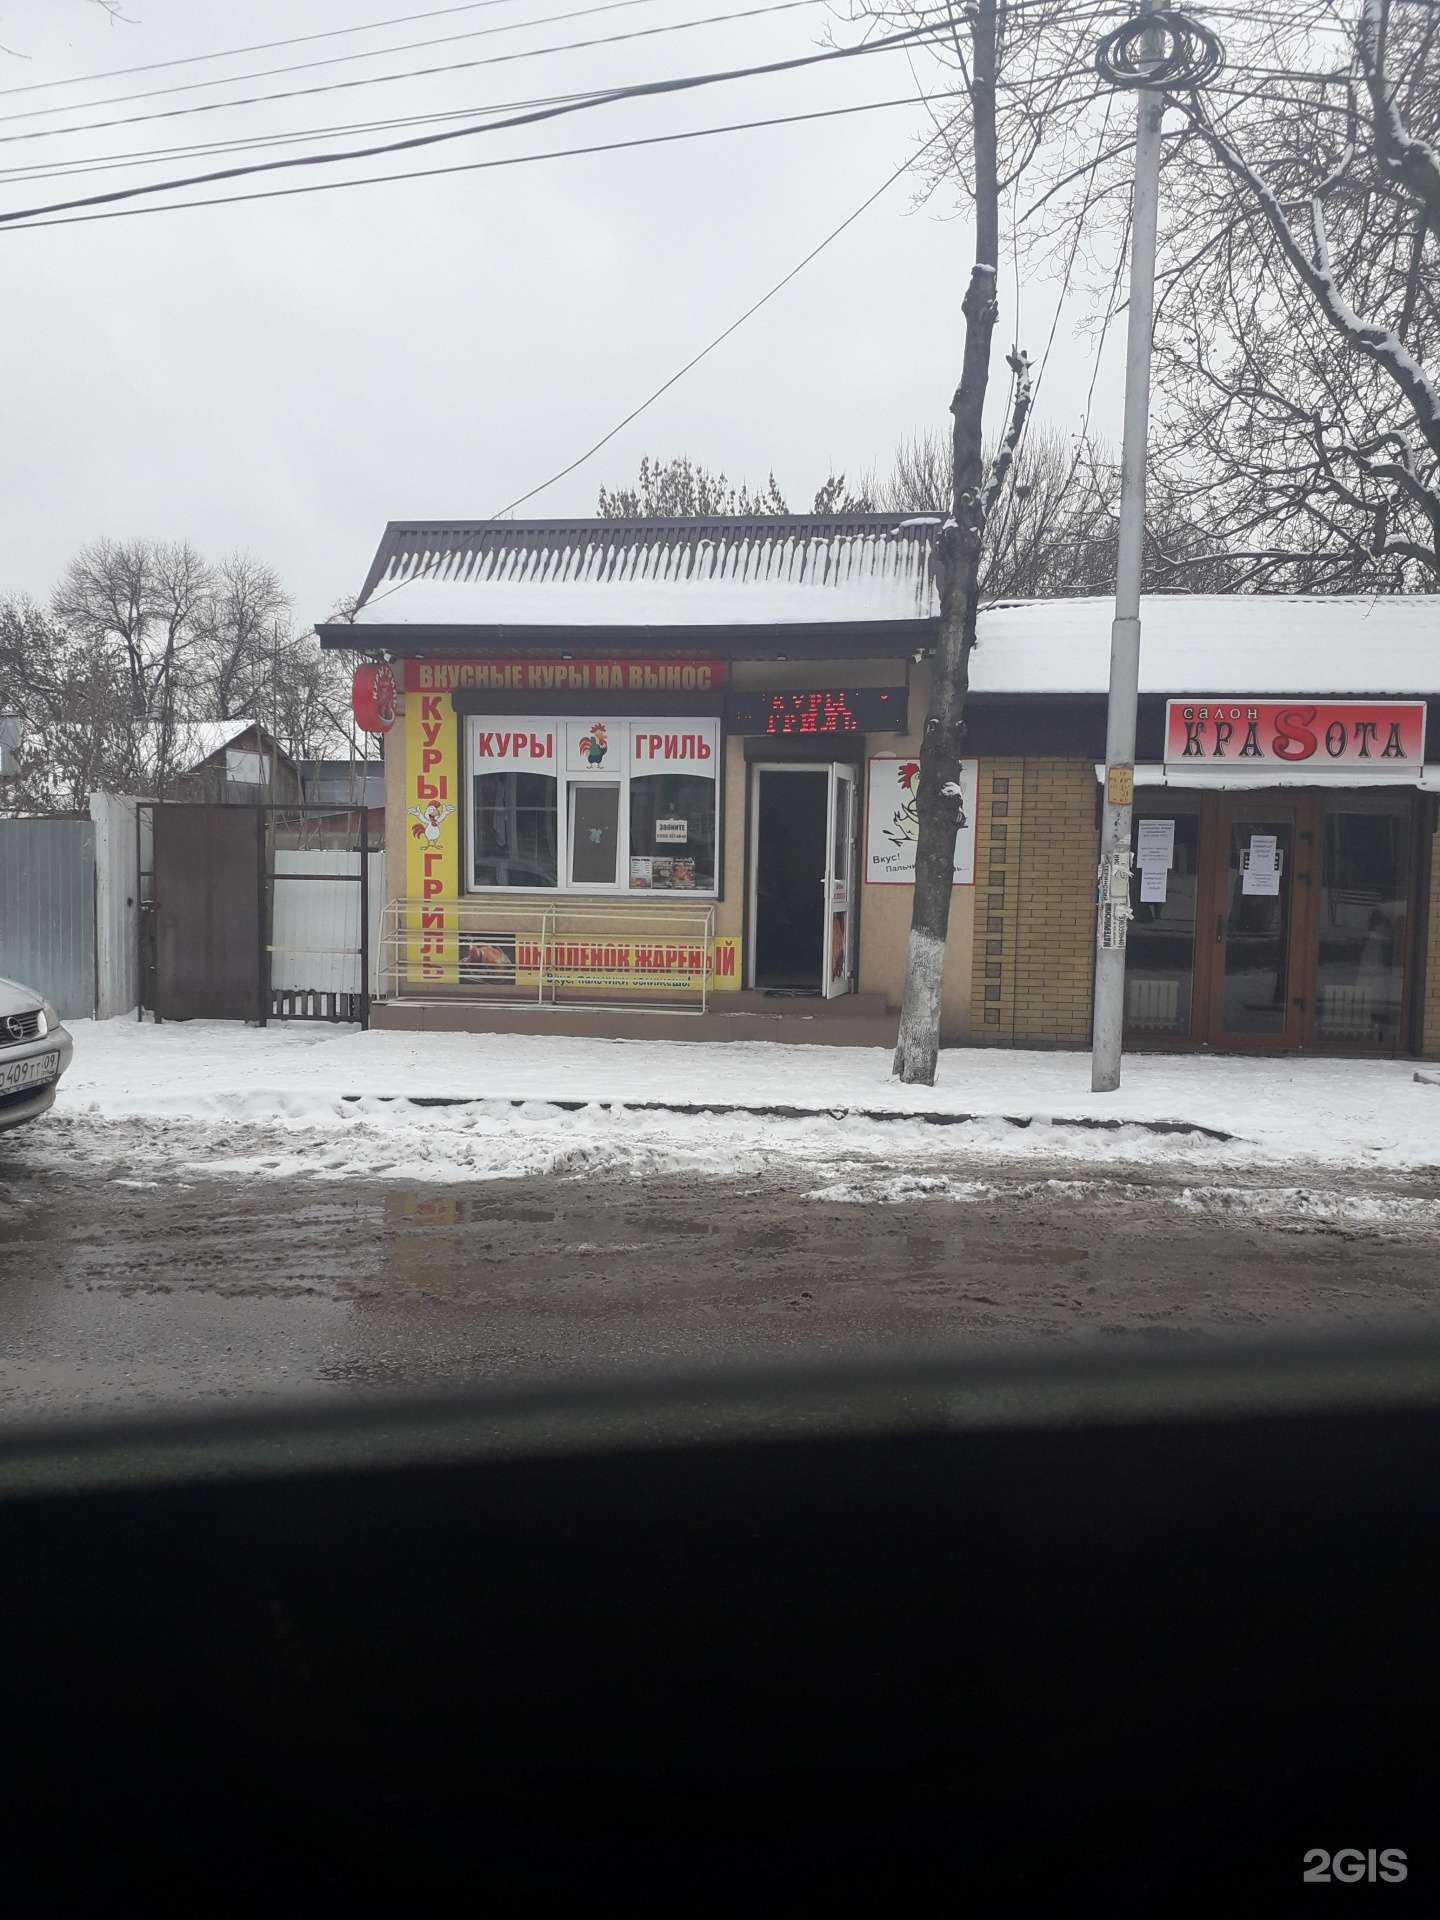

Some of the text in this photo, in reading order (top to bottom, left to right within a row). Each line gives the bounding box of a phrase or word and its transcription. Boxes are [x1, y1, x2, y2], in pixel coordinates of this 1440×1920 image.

[419, 665, 523, 689] ВКУСНЫЕ
[528, 665, 589, 689] КУРЫ
[595, 666, 622, 689] НА
[629, 666, 712, 690] ВЫНОС
[1183, 706, 1260, 720] салон
[417, 696, 448, 800] КУРЫ
[479, 733, 553, 759] КУРЫ
[635, 735, 711, 760] ГРИЛЬ
[872, 853, 900, 864] Вкус!
[420, 853, 444, 980] ГРИЛЬ
[518, 941, 630, 972] ЦЫПЛЕНОК
